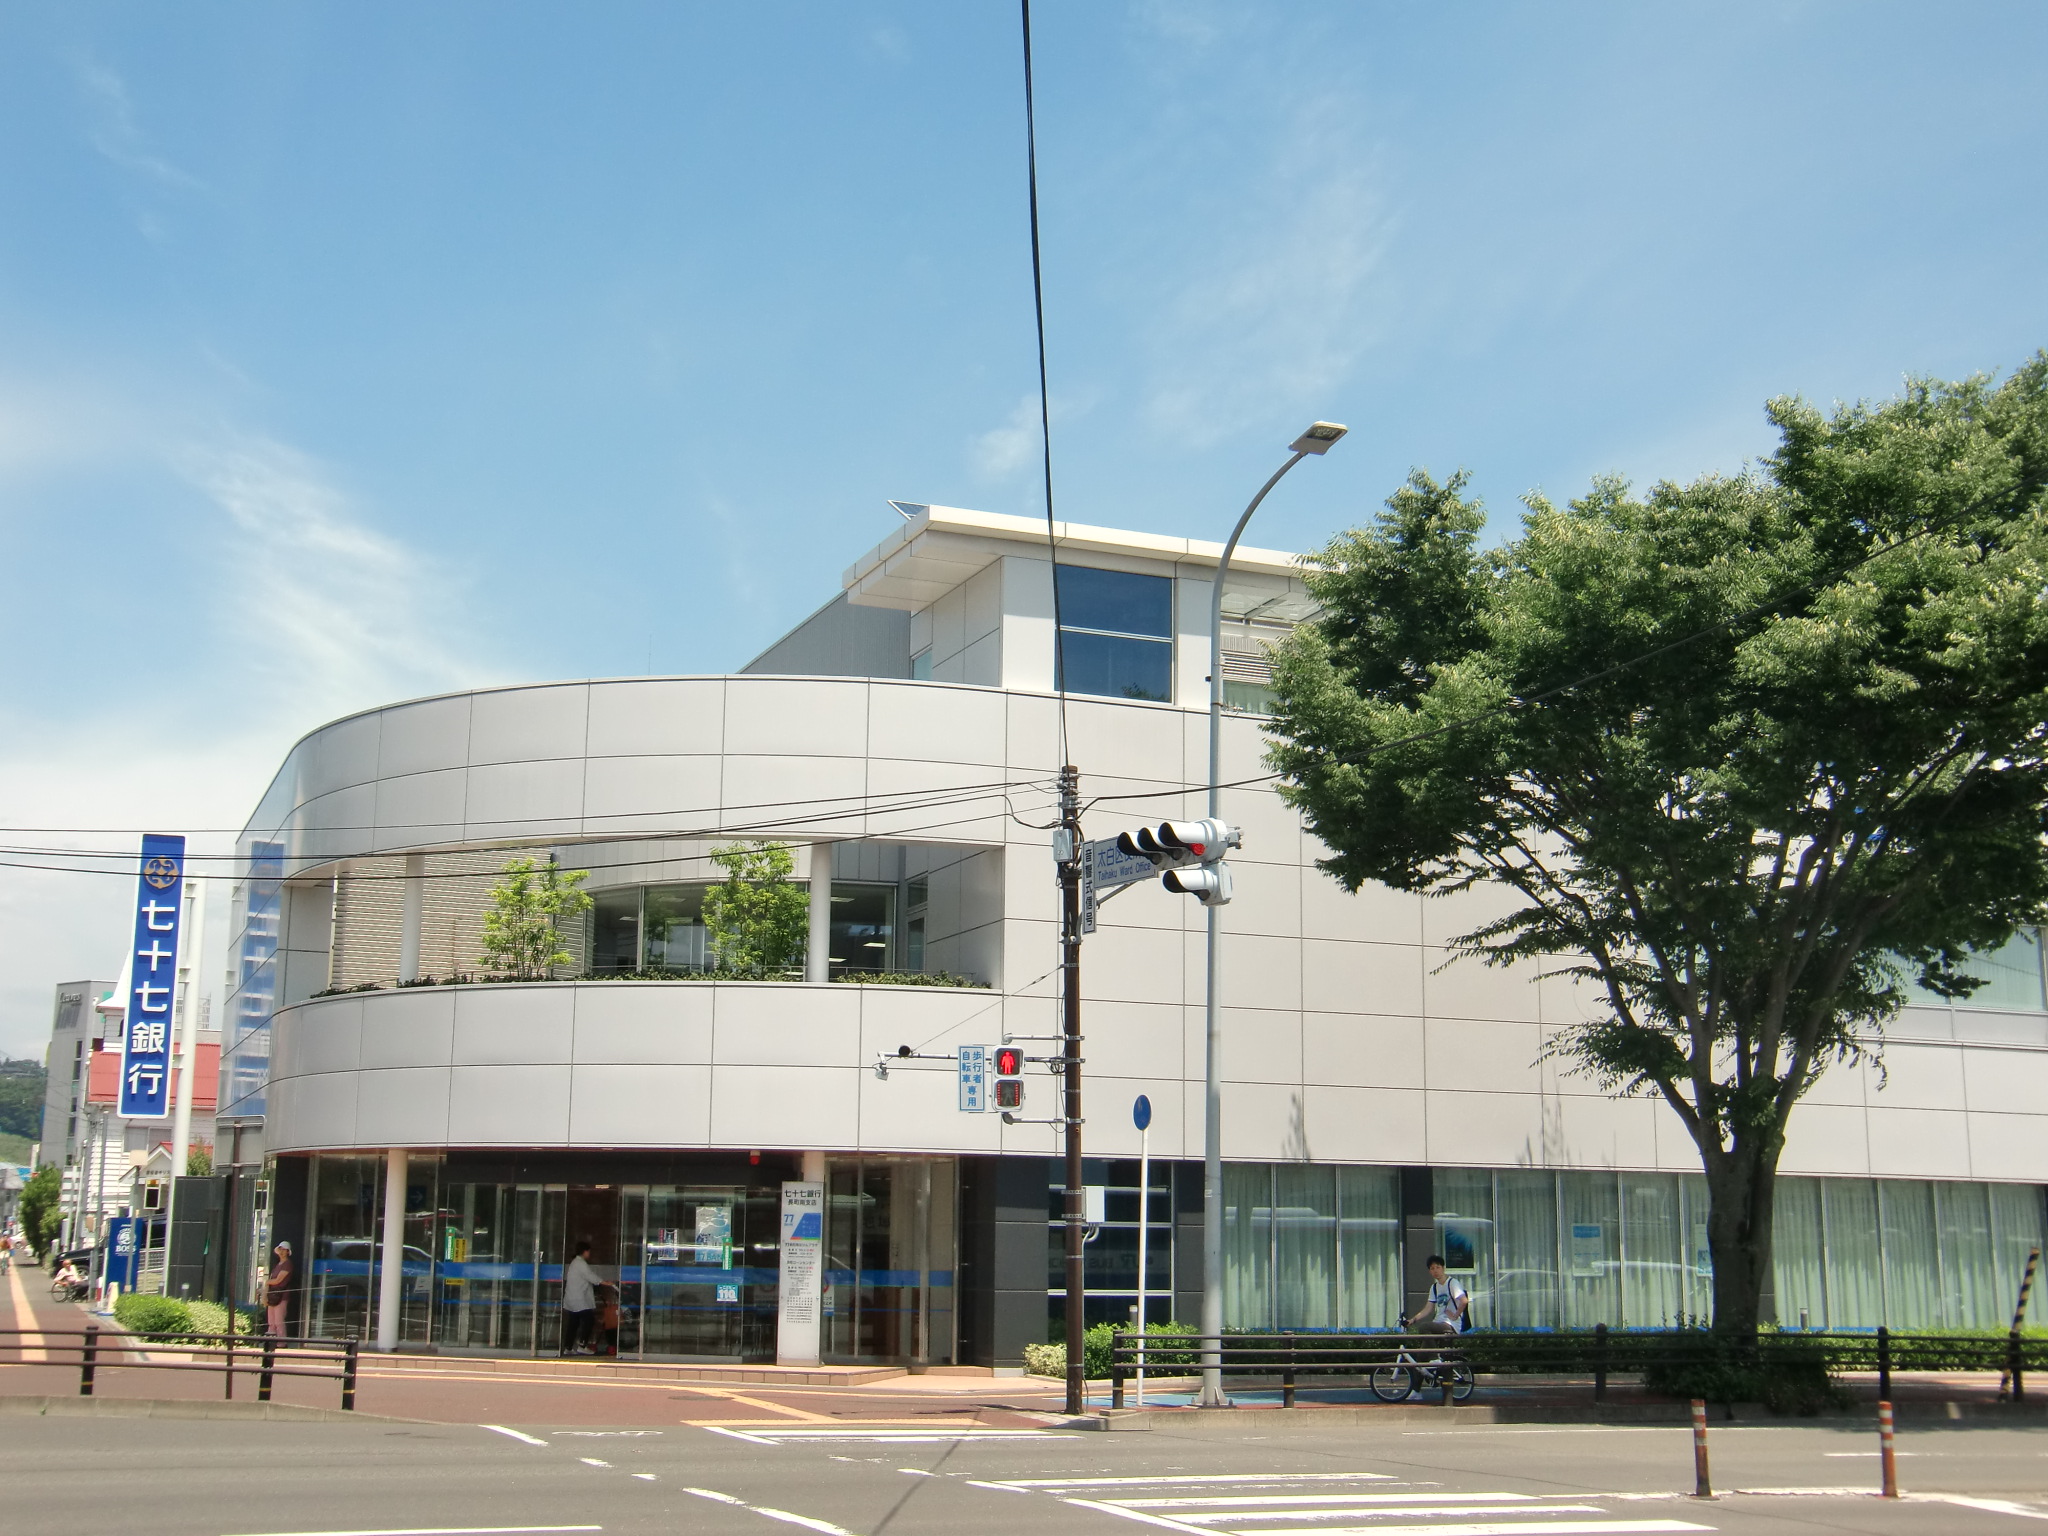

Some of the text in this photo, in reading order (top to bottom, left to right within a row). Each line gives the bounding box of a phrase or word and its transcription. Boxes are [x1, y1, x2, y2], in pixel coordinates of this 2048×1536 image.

[1098, 861, 1151, 881] Taihaku Ward Office
[128, 899, 176, 1095] 七十七銀行
[967, 1085, 977, 1107] 専用
[784, 1189, 821, 1198] 七十七銀行
